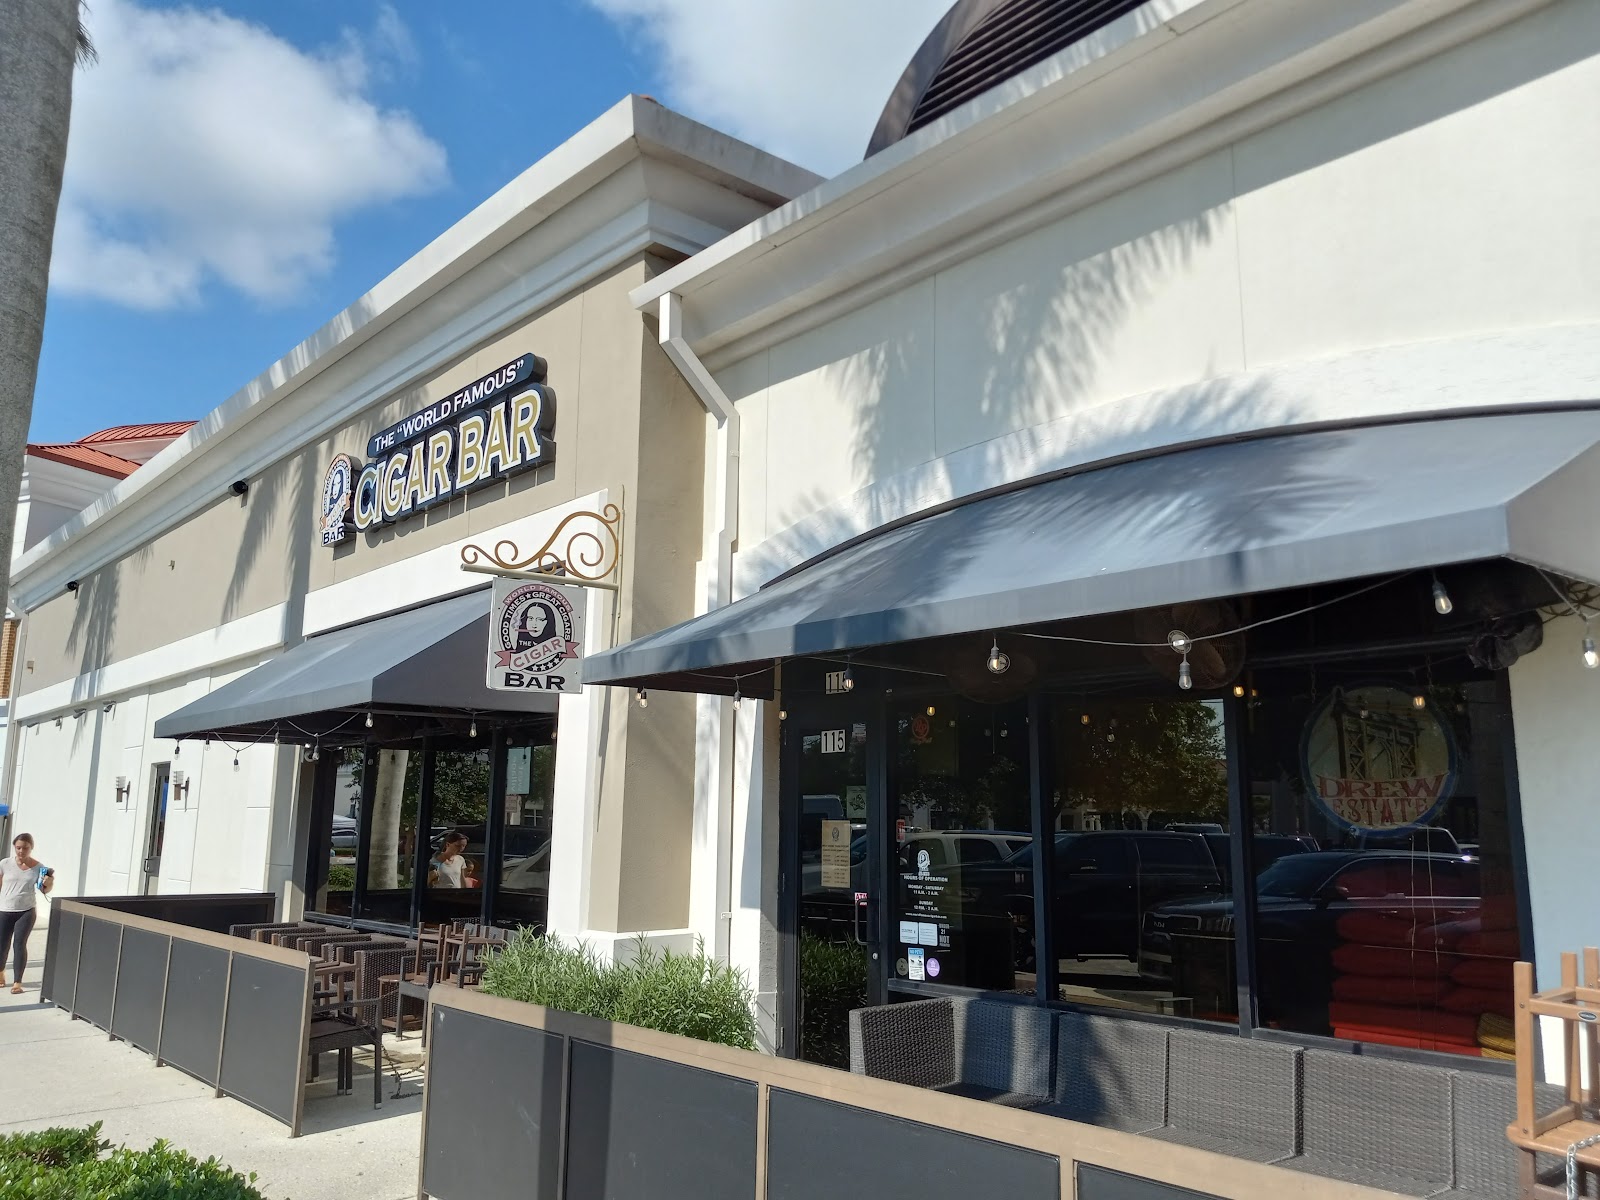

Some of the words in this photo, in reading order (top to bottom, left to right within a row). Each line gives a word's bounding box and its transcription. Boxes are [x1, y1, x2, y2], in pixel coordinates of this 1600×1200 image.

[374, 435, 395, 452] THE
[353, 430, 451, 530] CIGAR
[455, 389, 541, 490] BAR
[323, 526, 344, 545] BAR
[505, 595, 526, 619] TIMES
[506, 585, 536, 604] WORLD
[539, 585, 573, 612] FAMOUS
[532, 591, 560, 608] GREAT
[559, 606, 571, 641] CIGARS
[502, 621, 511, 649] GOOD
[513, 638, 562, 668] CIGAR
[504, 672, 565, 690] BAR
[823, 731, 844, 752] 115
[1316, 772, 1450, 798] DREW
[1332, 798, 1428, 826] ESTATE
